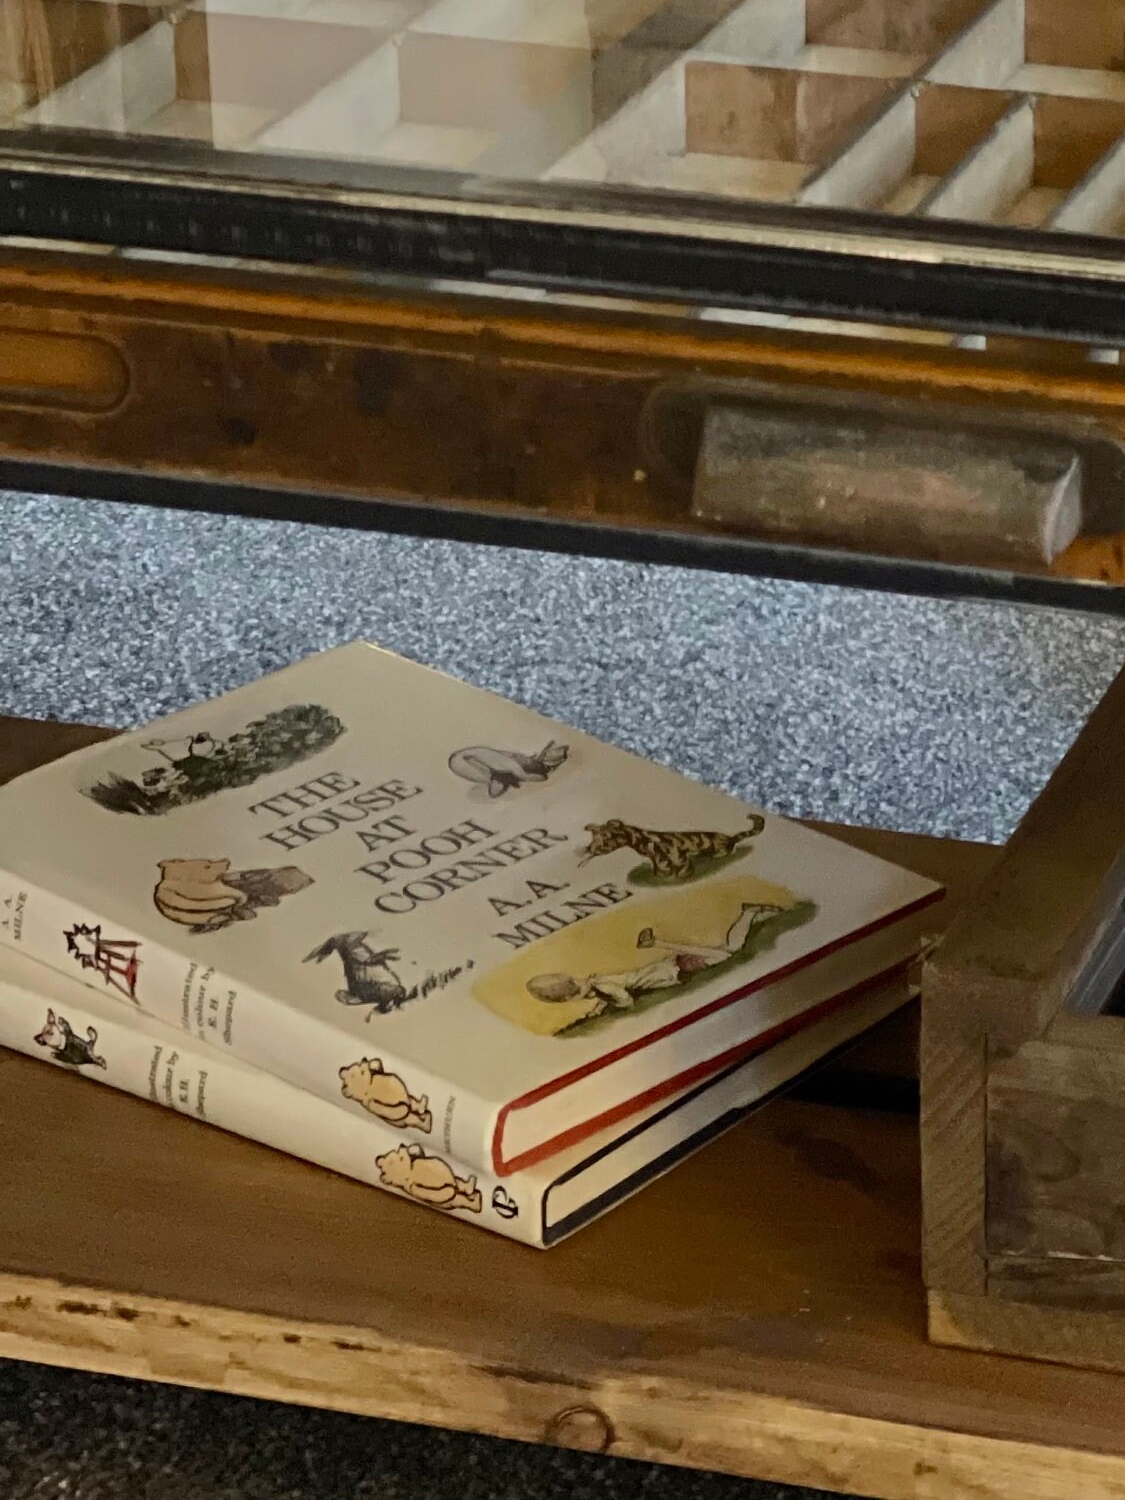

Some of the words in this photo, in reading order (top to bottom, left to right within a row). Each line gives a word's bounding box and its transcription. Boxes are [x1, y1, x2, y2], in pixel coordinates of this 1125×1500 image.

[248, 771, 361, 819] THE
[259, 778, 424, 852] HOUSE
[353, 819, 500, 884] POOH
[355, 813, 418, 852] AT
[373, 826, 569, 915] CORNER
[492, 882, 634, 949] MILNE
